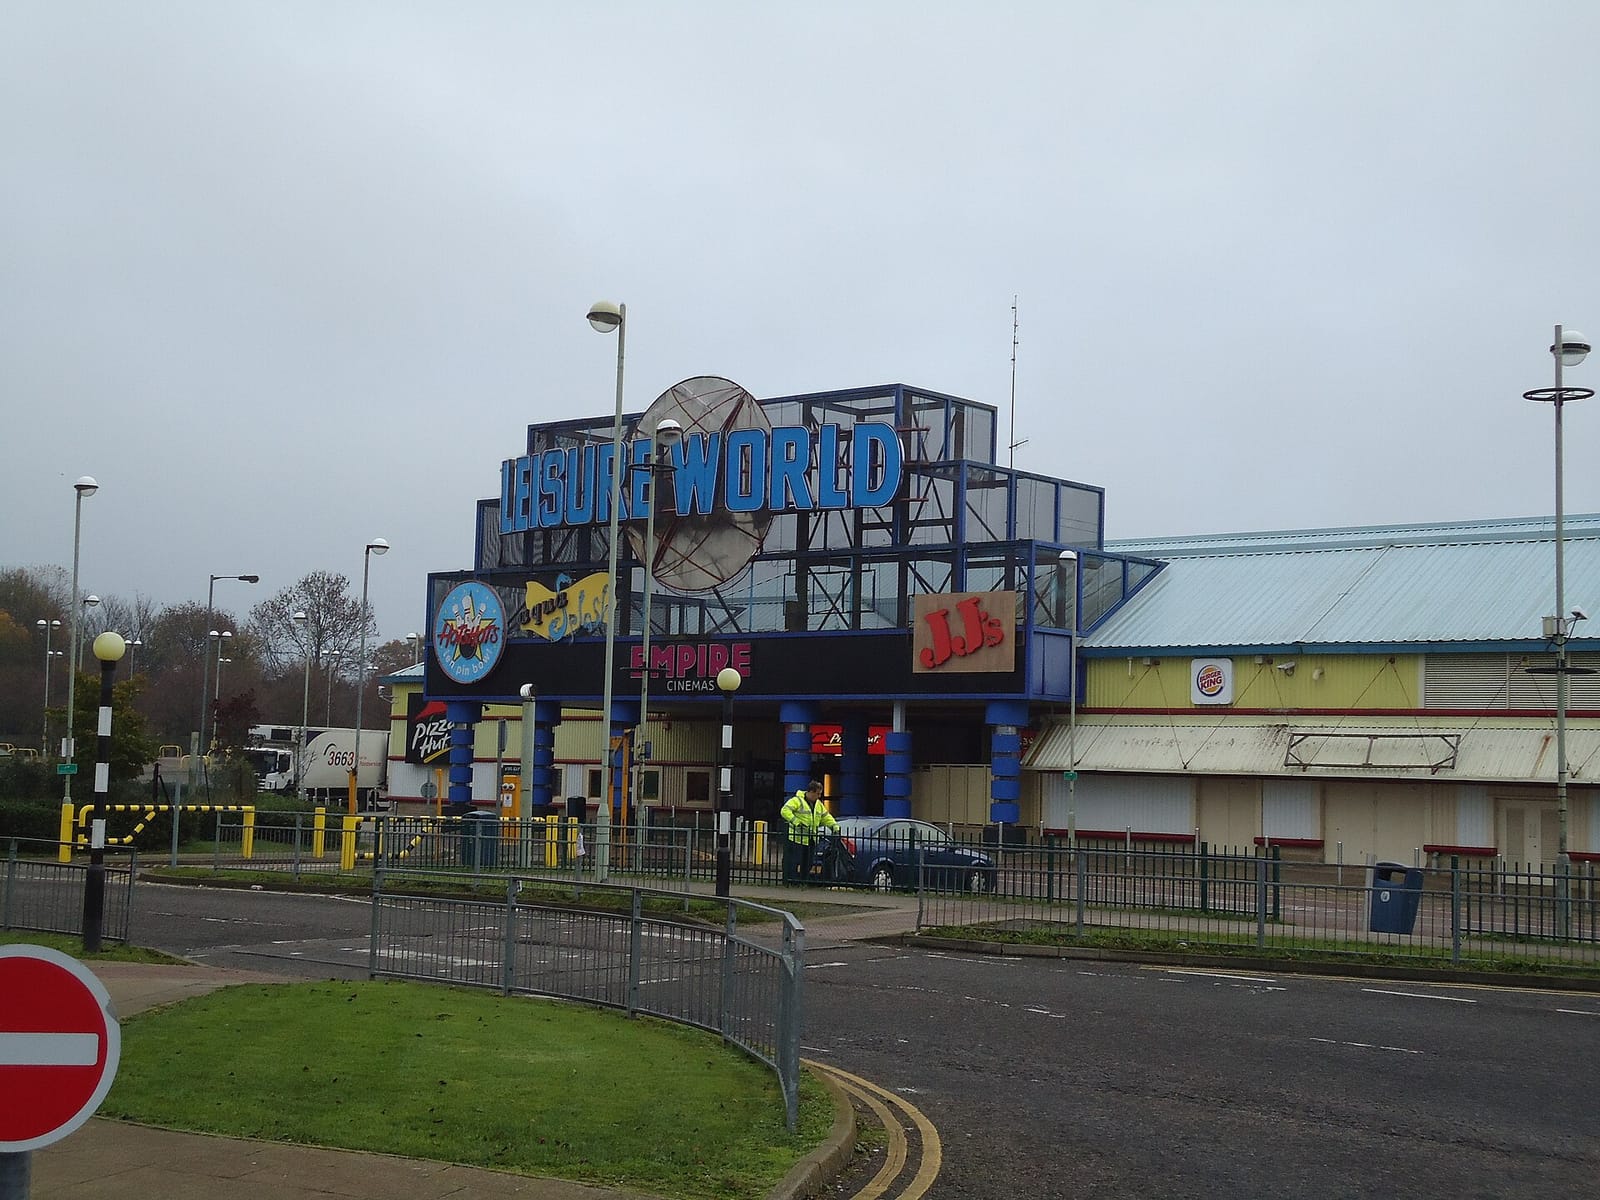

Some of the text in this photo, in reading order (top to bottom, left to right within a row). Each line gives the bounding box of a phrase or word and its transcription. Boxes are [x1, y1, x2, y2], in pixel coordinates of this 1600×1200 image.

[499, 422, 902, 535] LEISURE WORLD
[442, 647, 493, 676] ten pin bowl
[630, 643, 752, 679] EMPIRE
[666, 680, 715, 692] CINEMAS
[1200, 670, 1221, 682] BURGER
[1200, 676, 1222, 690] KING
[411, 719, 455, 750] Pizza
[420, 733, 452, 758] Hut
[328, 751, 355, 766] 3663
